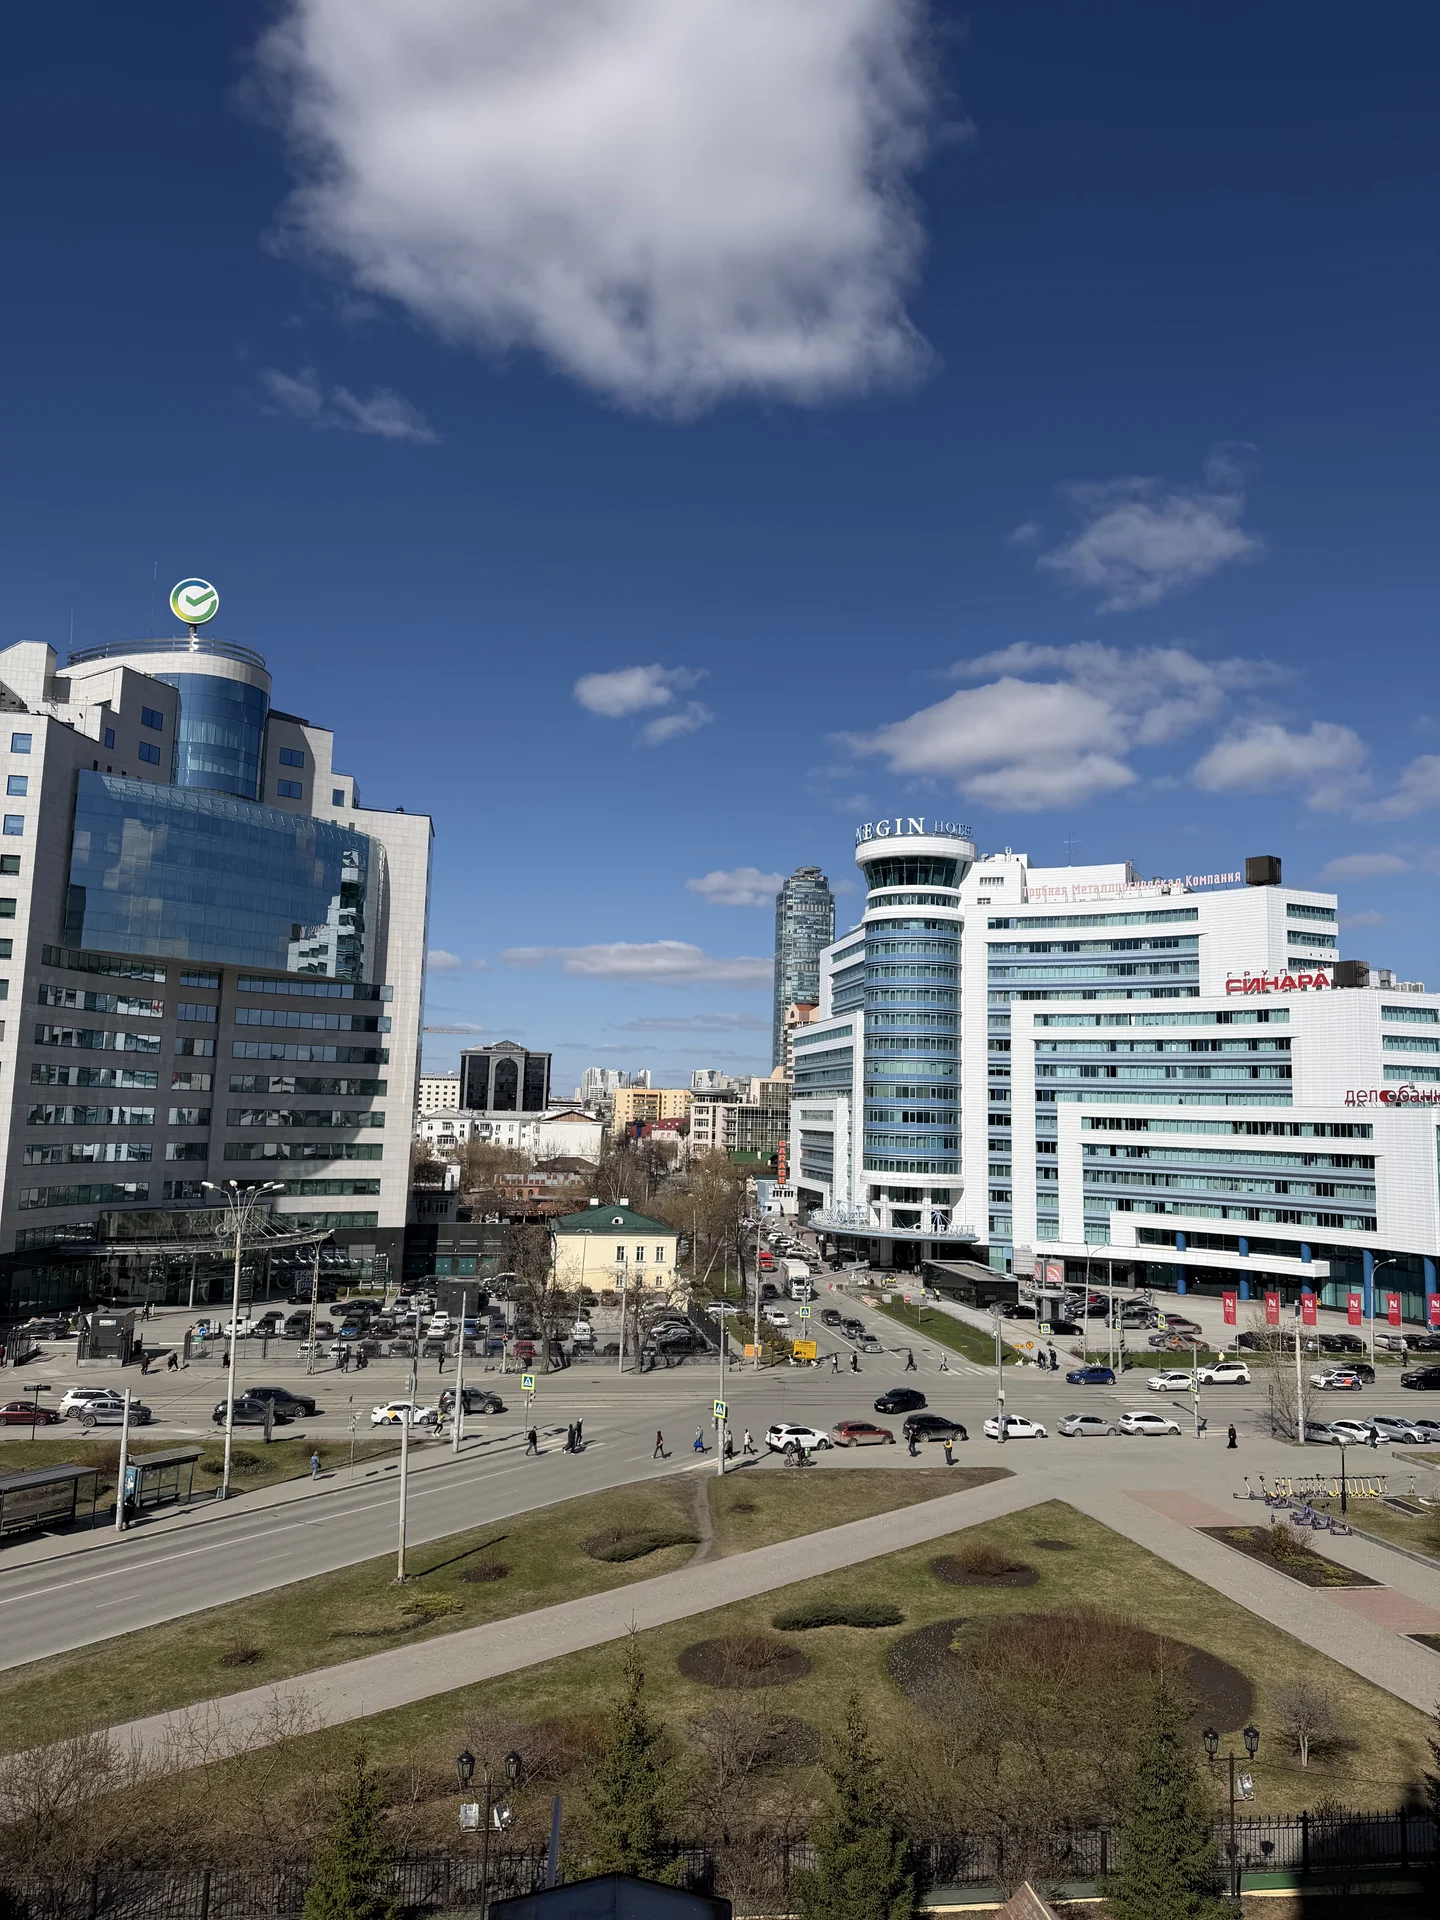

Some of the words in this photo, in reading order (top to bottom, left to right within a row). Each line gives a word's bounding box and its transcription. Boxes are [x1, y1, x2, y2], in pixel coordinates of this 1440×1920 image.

[933, 820, 975, 838] HOTE
[1022, 884, 1067, 899] Трубная
[1185, 871, 1241, 887] Компания
[1226, 965, 1325, 978] ГРУППА
[1225, 973, 1330, 993] СИНАРА
